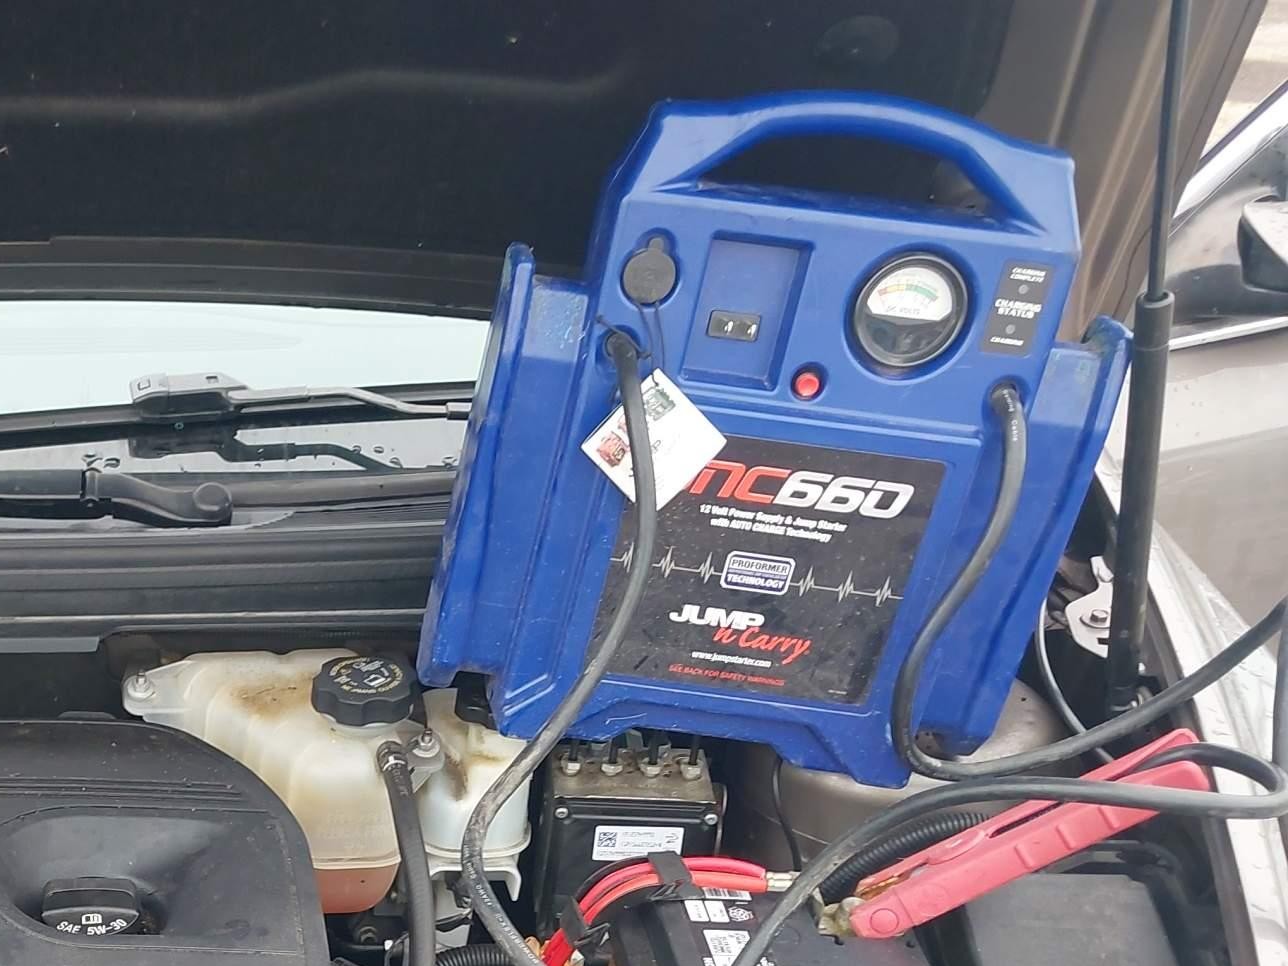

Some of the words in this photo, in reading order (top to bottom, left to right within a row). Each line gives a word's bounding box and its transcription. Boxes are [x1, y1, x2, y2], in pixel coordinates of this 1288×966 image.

[994, 298, 1042, 313] CHARGING
[997, 307, 1035, 319] STATUS
[699, 503, 711, 513] 12
[711, 504, 728, 516] Volt
[728, 506, 755, 519] Power
[755, 511, 785, 525] Supply
[785, 516, 793, 525] &
[792, 517, 817, 529] Jump
[817, 520, 848, 532] Starter
[710, 517, 730, 528] with
[729, 519, 752, 530] AUTO
[752, 523, 786, 535] CHARGE
[786, 527, 832, 543] Technology
[731, 559, 788, 574] PROFORMER
[727, 573, 785, 589] TECHNOLOGY
[669, 603, 765, 630] JUMP
[683, 666, 703, 675] BACK
[704, 669, 719, 677] FOR
[719, 671, 747, 681] SAFETY
[56, 921, 81, 934] SAE
[87, 918, 128, 935] 5W-30
